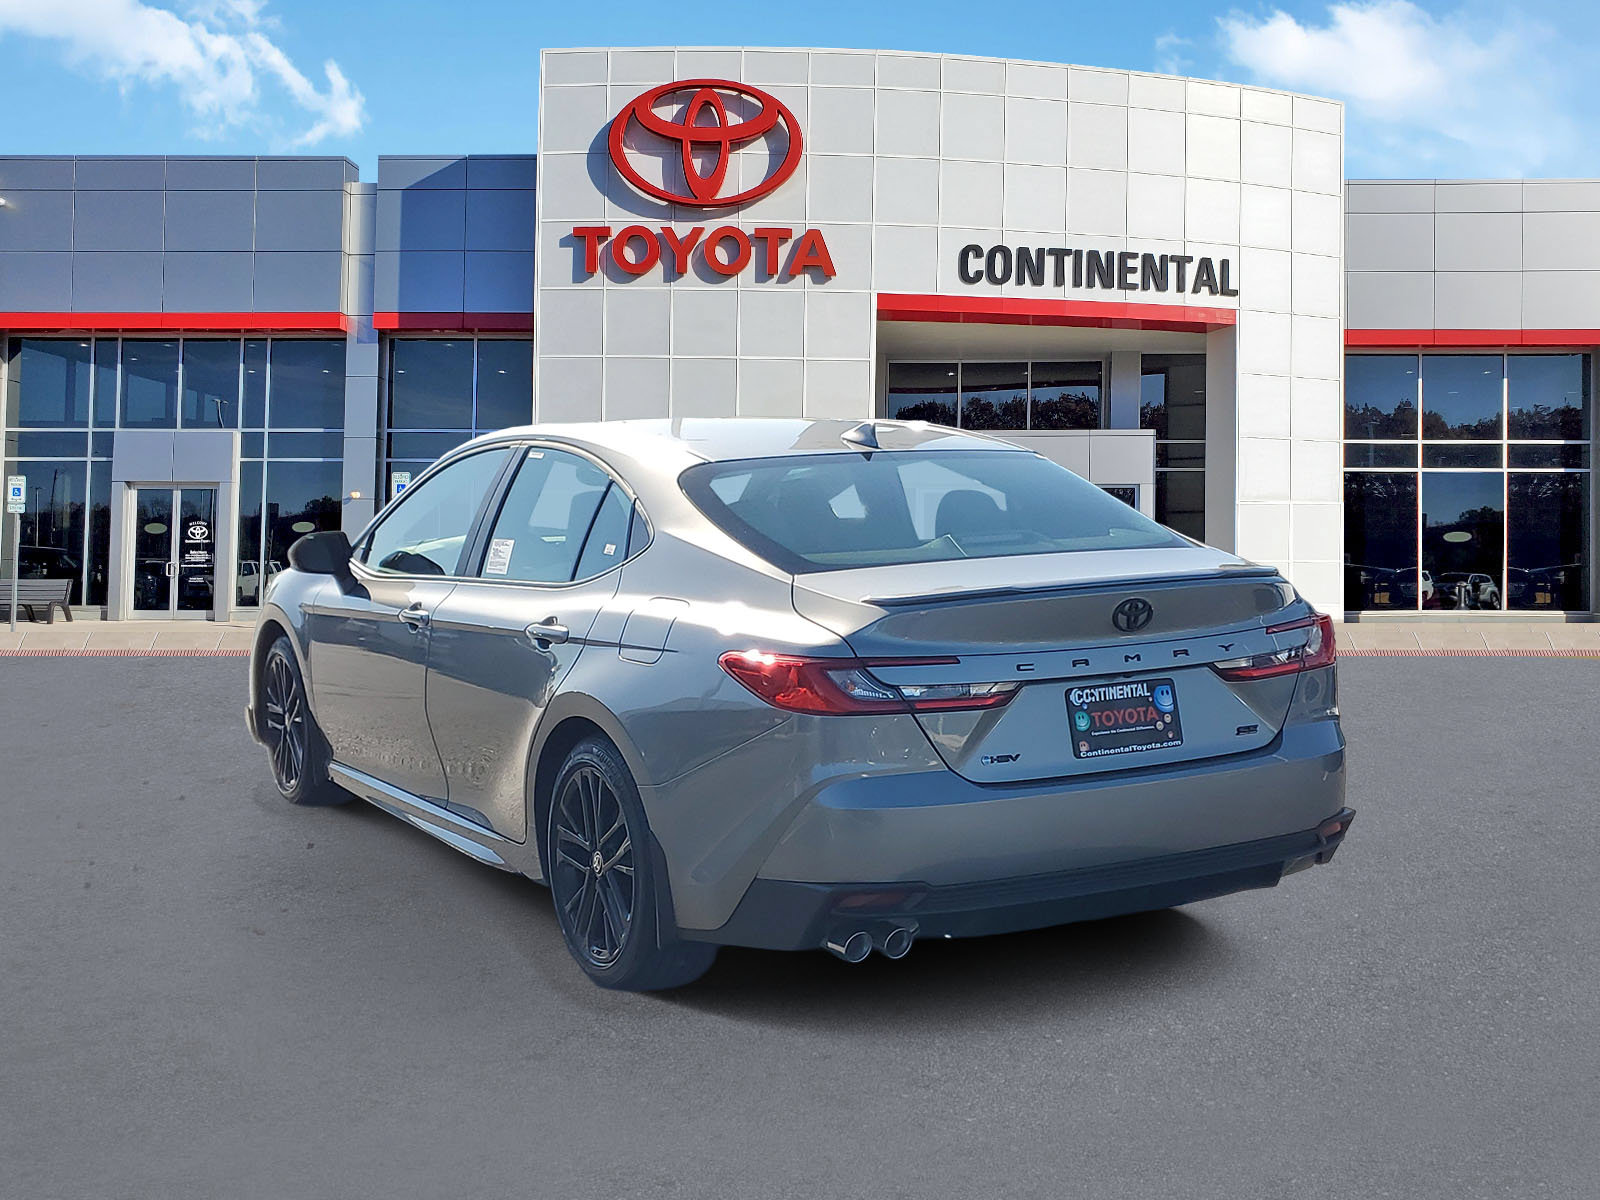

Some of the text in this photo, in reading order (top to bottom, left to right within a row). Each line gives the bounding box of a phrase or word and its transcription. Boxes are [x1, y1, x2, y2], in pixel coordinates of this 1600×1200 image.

[573, 225, 837, 279] TOYOTA
[958, 243, 1239, 298] CONTINENTAL
[1016, 643, 1235, 671] CAMRY
[1072, 682, 1151, 704] CONTINENTAL
[1091, 706, 1159, 727] TOYOTA
[990, 753, 1021, 764] HEV
[1080, 740, 1182, 757] ContinentalToyota.com
